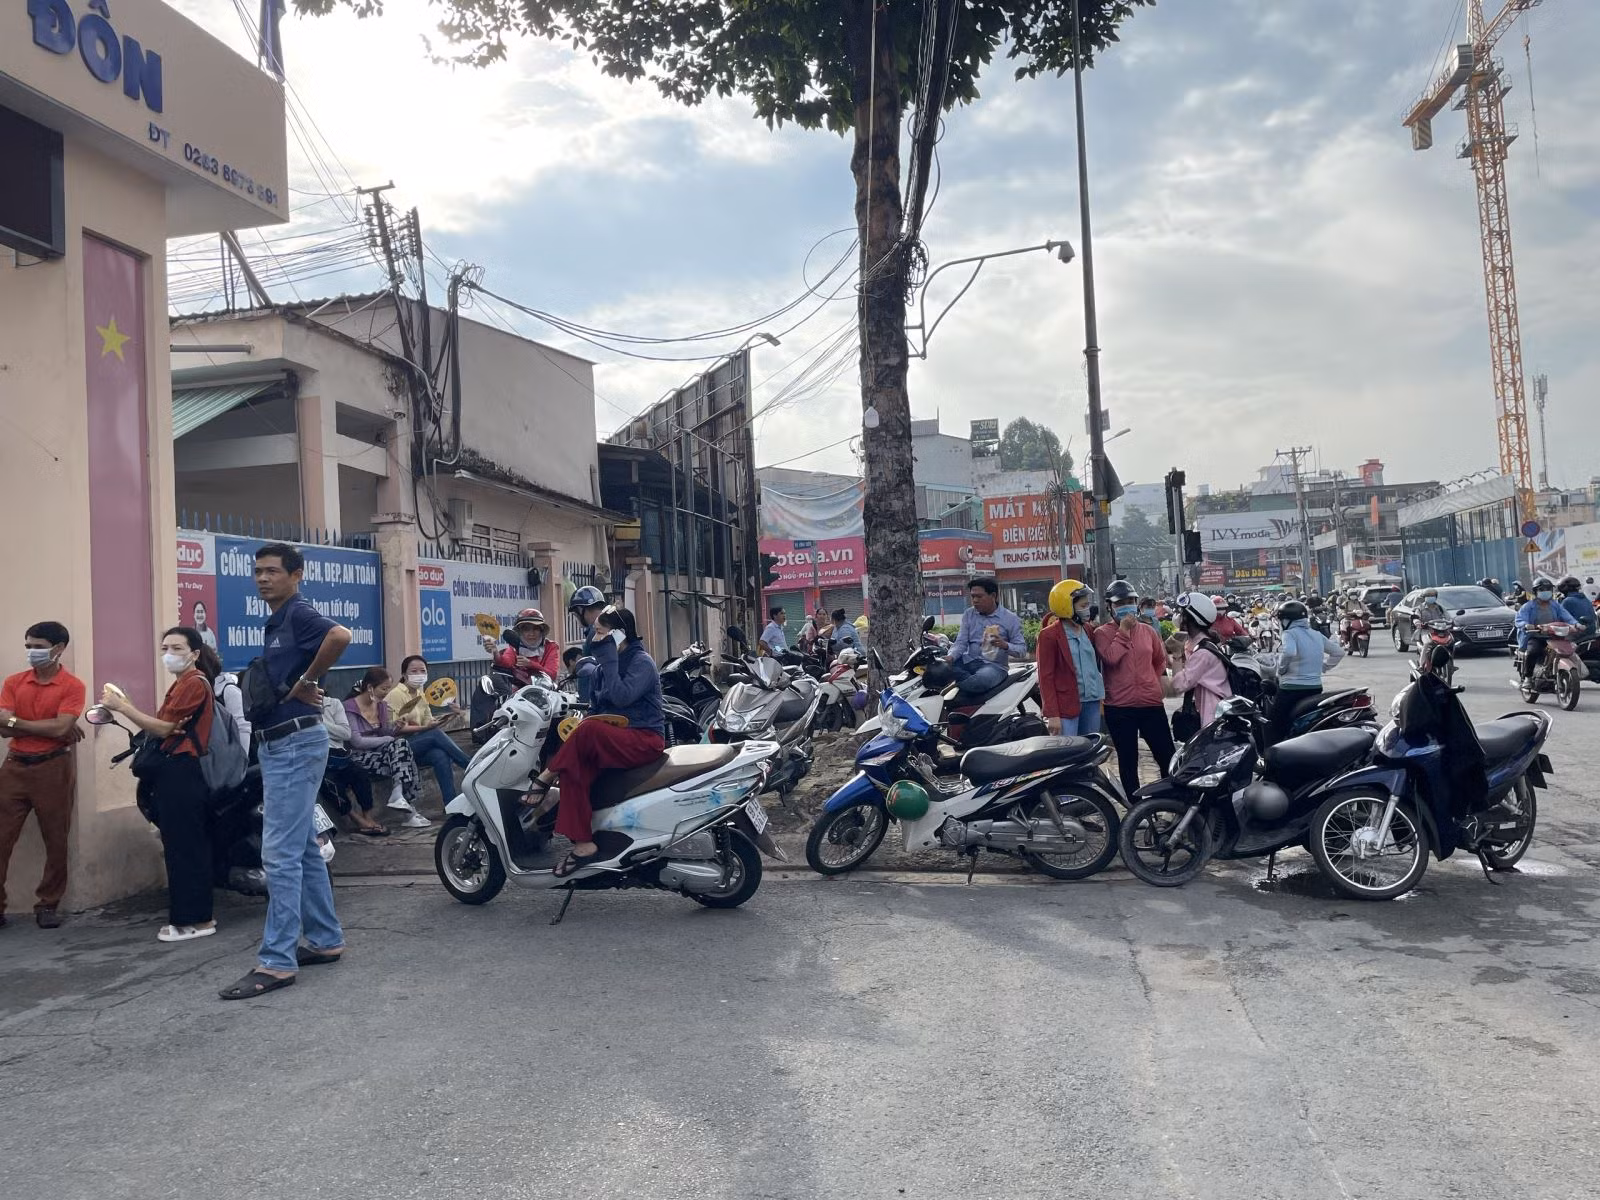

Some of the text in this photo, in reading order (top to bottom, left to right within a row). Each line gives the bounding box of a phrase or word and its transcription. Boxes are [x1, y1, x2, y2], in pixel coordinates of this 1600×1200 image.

[990, 496, 1025, 519] MẮT
[1002, 524, 1025, 544] ĐIỆN
[220, 546, 251, 577] CỔNG
[302, 559, 323, 586] ẠCH,
[342, 563, 354, 584] AN
[354, 562, 376, 586] TOÀN
[920, 553, 940, 563] Mart
[1002, 552, 1029, 563] TRUNG
[1031, 550, 1049, 561] TÂM
[798, 569, 822, 579] PIZAA
[192, 582, 203, 591] Duy
[246, 595, 265, 618] Xây
[330, 598, 343, 617] tốt
[344, 600, 360, 621] đẹp
[421, 598, 446, 626] ola
[228, 625, 246, 647] Nói
[247, 626, 265, 646] khô
